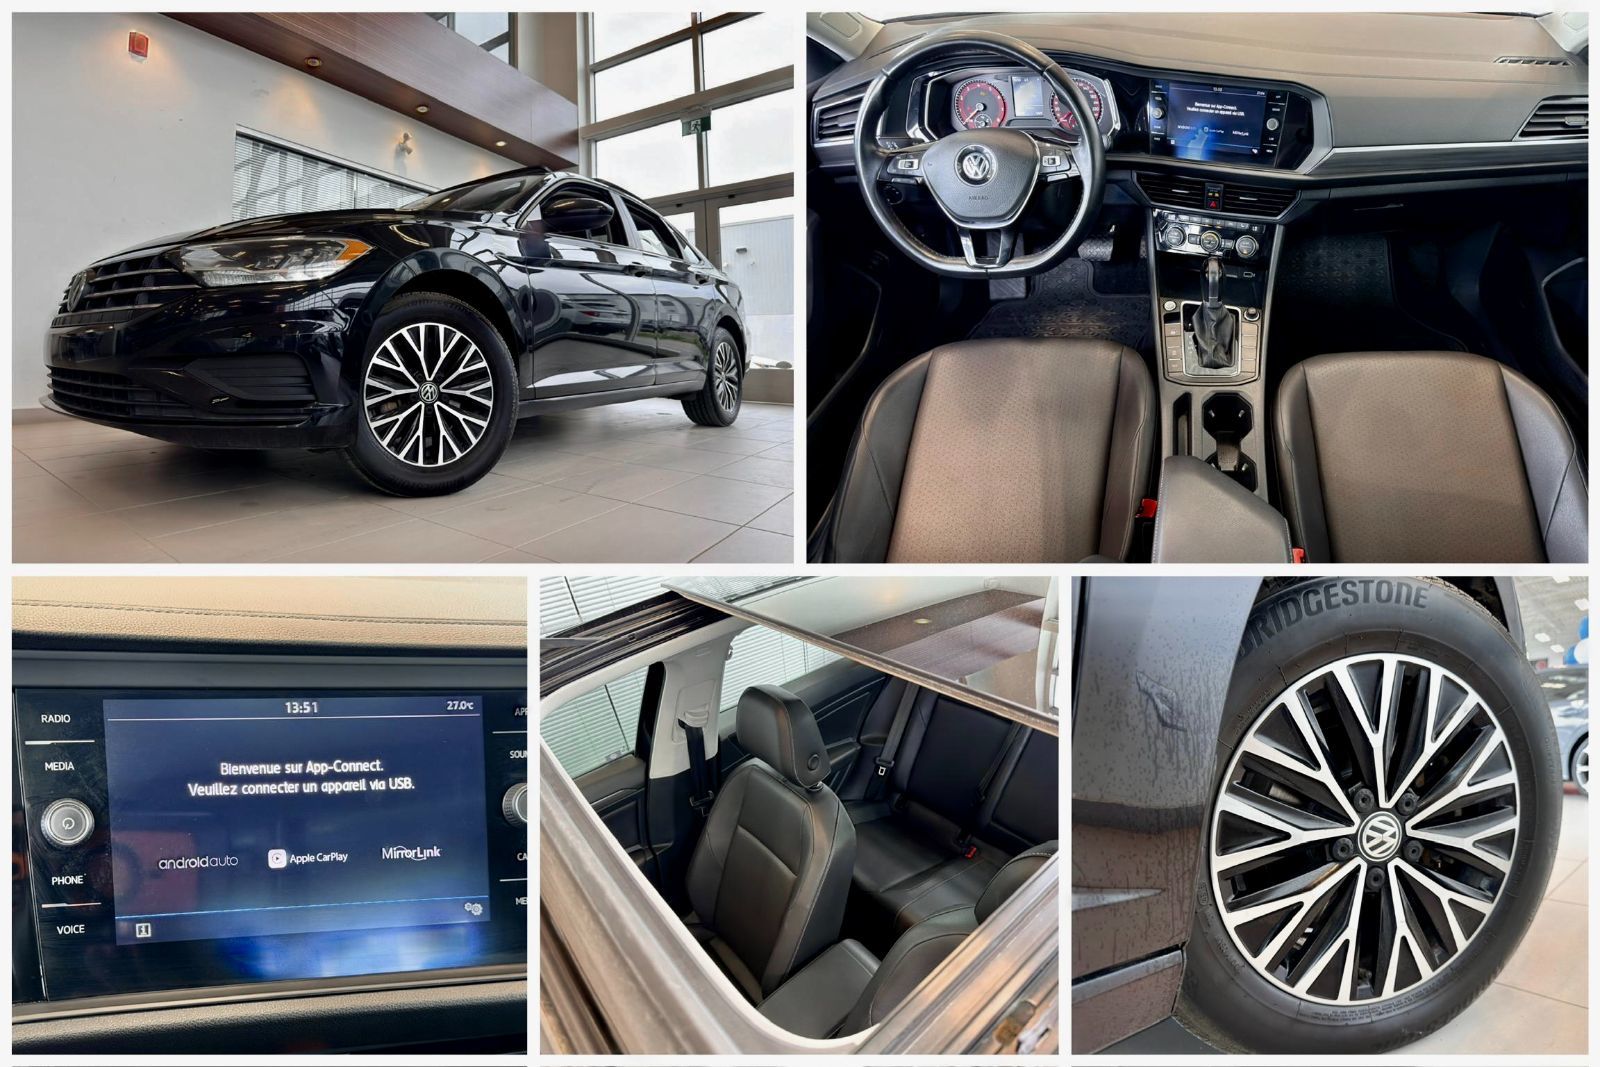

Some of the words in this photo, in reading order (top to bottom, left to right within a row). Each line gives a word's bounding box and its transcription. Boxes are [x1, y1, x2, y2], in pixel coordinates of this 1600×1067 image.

[285, 701, 318, 714] 13:51
[41, 714, 71, 723] RADIO
[44, 761, 75, 771] MEDIA
[220, 762, 281, 776] Bienvenue
[285, 763, 303, 774] sur
[305, 759, 384, 775] App-Connect.
[187, 782, 238, 797] Veuillez
[241, 781, 300, 795] connecter
[302, 781, 318, 793] un
[321, 778, 367, 794] appareil
[369, 777, 386, 790] via
[388, 776, 415, 790] USB.
[289, 853, 315, 864] Apple
[316, 851, 349, 863] CarPlay
[381, 845, 441, 861] MirrorLink
[51, 875, 84, 886] PHONE
[56, 924, 85, 935] VOICE
